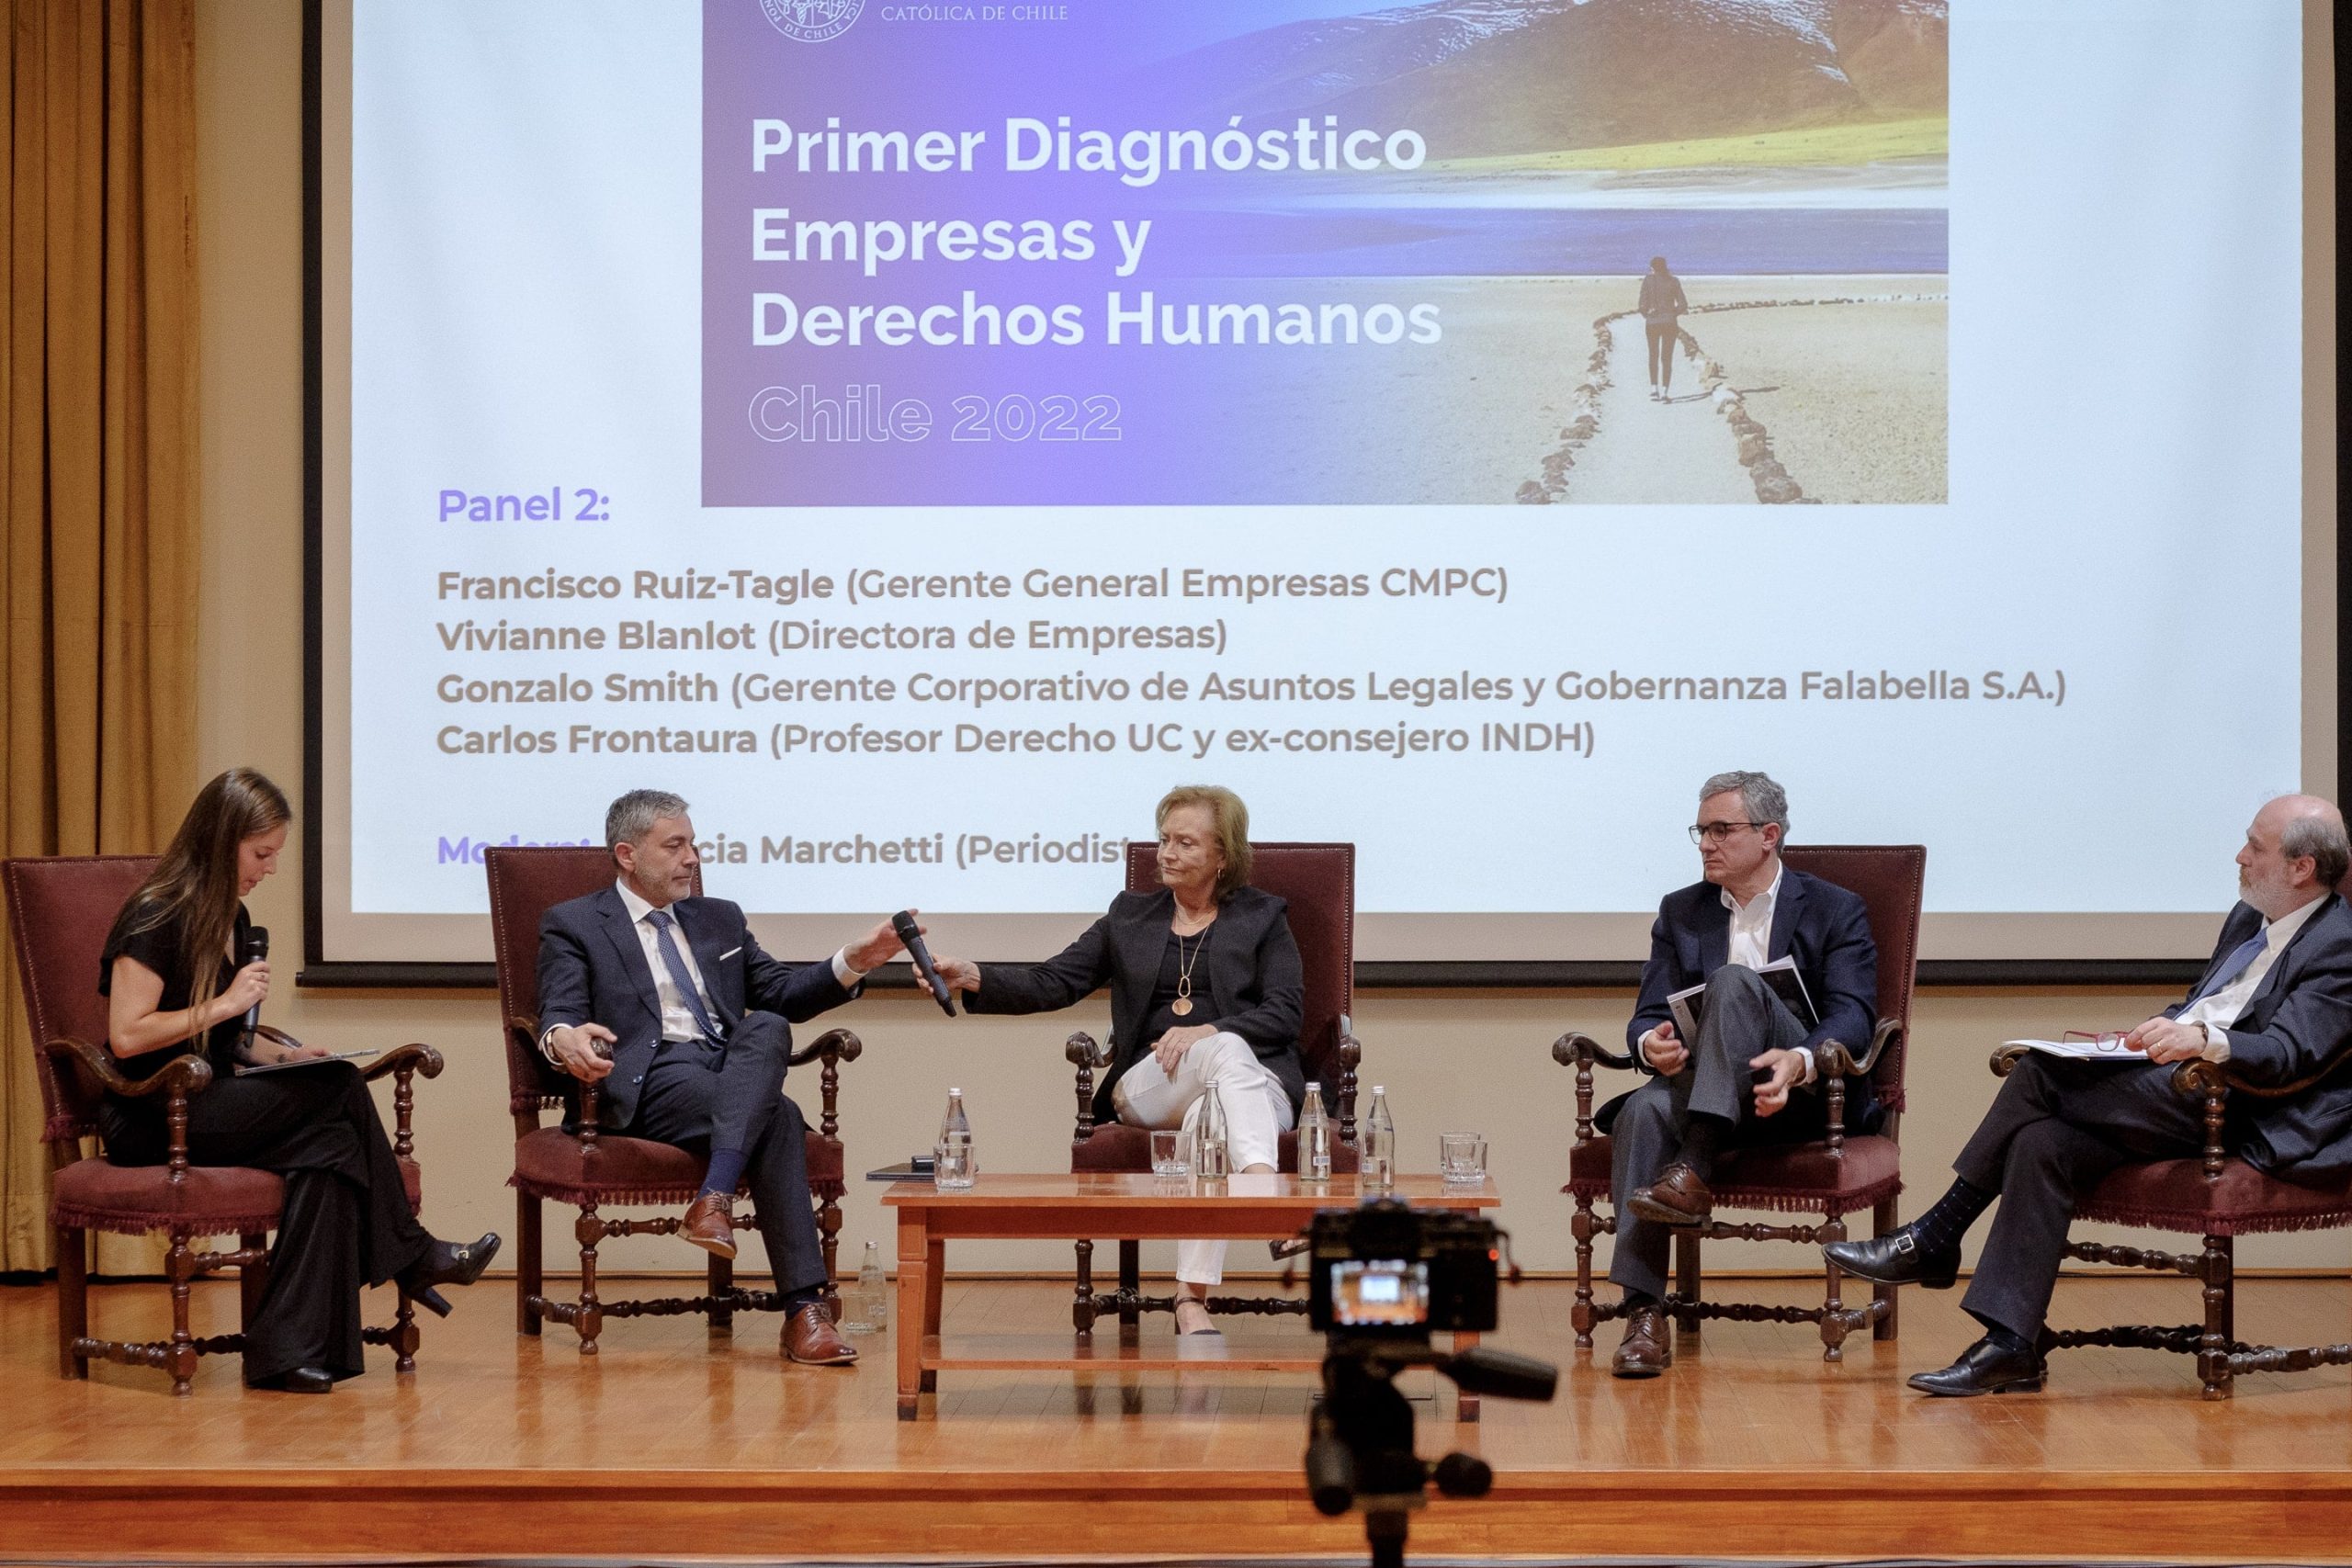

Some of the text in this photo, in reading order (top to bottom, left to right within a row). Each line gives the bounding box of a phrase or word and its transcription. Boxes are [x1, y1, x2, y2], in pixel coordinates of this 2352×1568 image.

[784, 22, 842, 39] DE CHILE
[881, 3, 1069, 21] CATÓLICA DE CHILE
[752, 115, 1427, 187] Primer Diagnóstico
[752, 208, 1152, 276] Empresas y
[752, 290, 1442, 346] Derechos Humanos
[748, 385, 1122, 442] Chile 2022
[439, 486, 610, 523] Panel 2:
[438, 567, 1509, 605] Francisco Ruiz-Tagle (Gerente General Empresas CMPC)
[436, 618, 1227, 658] Vivianne Blanlot (Directora de Empresas)
[437, 670, 2067, 710] Gonzalo Smith (Gerente Corporativo de Asuntos Legales y Gobernanza Falabella S.A.)
[437, 721, 1596, 761] Carlos Frontaura (Profesor Derecho UC y ex-consejero INDH)
[698, 832, 1127, 870] cia Marchetti (Periodist
